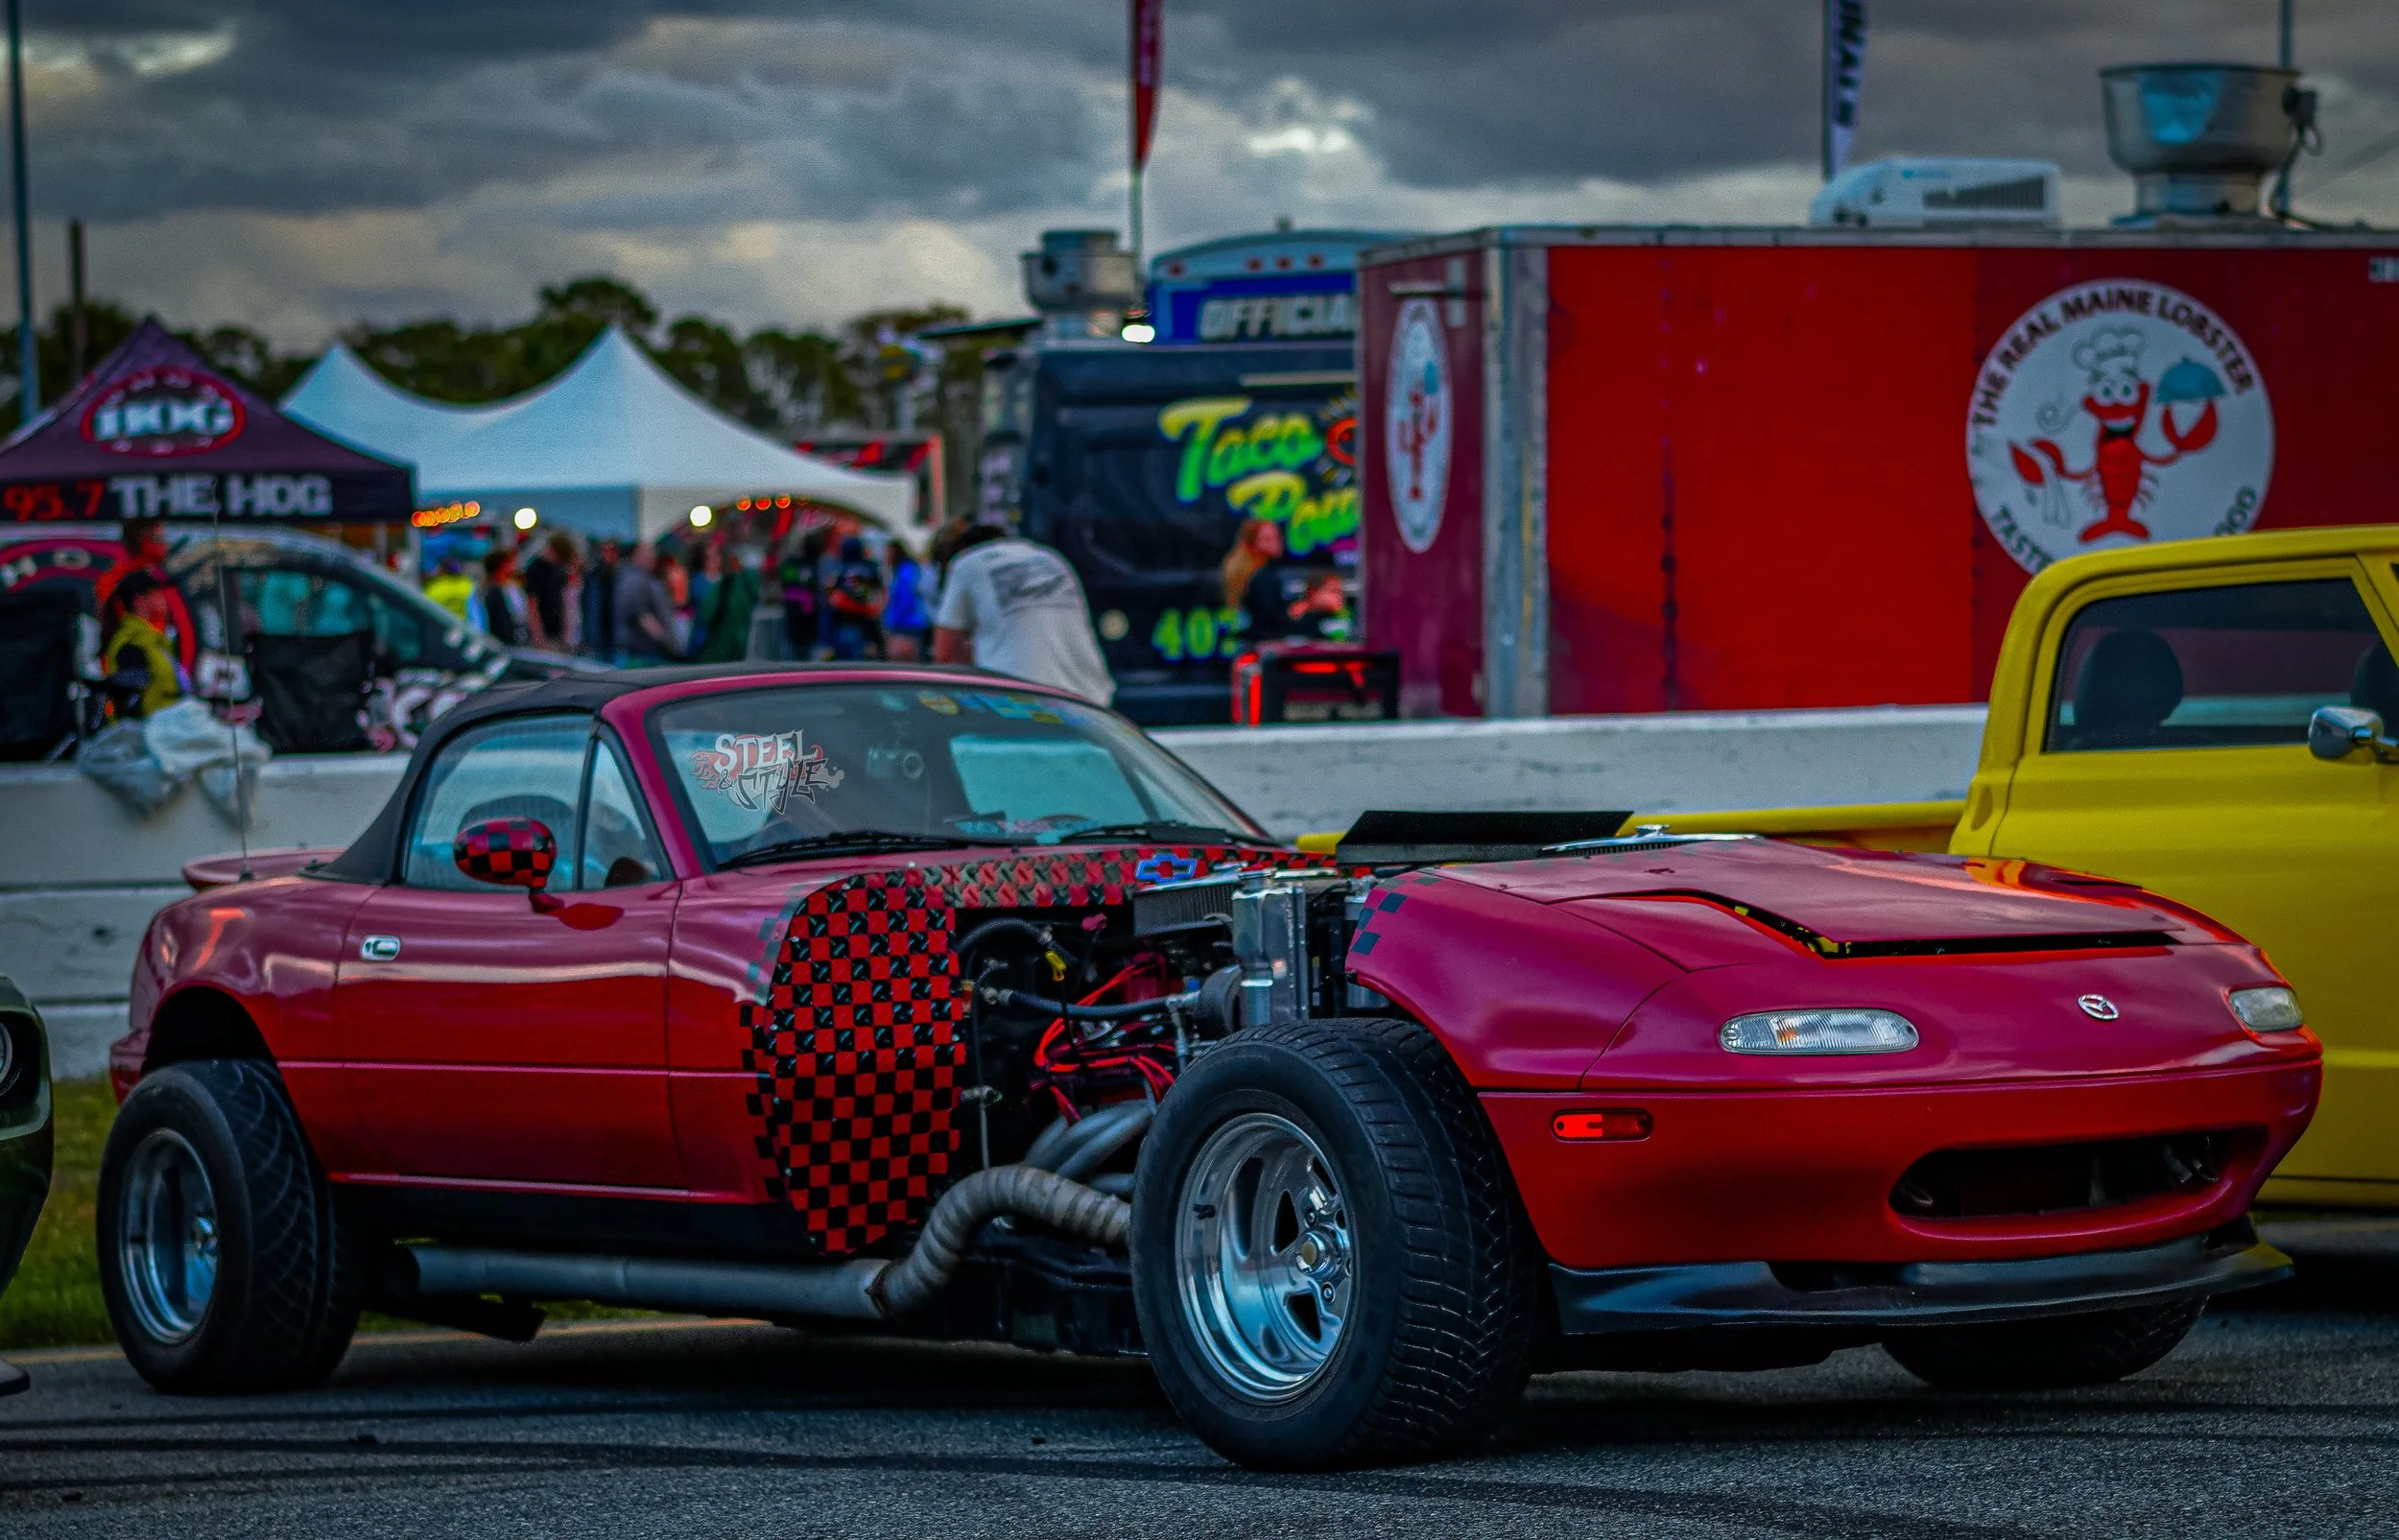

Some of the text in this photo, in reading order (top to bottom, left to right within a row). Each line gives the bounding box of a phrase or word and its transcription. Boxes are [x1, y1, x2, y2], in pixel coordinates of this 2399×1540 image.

[1971, 288, 2254, 428] THE REAL MAINE LOBSTER
[1157, 396, 1323, 505] Taco
[109, 475, 219, 519] THE
[225, 474, 334, 517] HOG
[714, 729, 818, 774] STEEL
[720, 757, 829, 816] & STYLE
